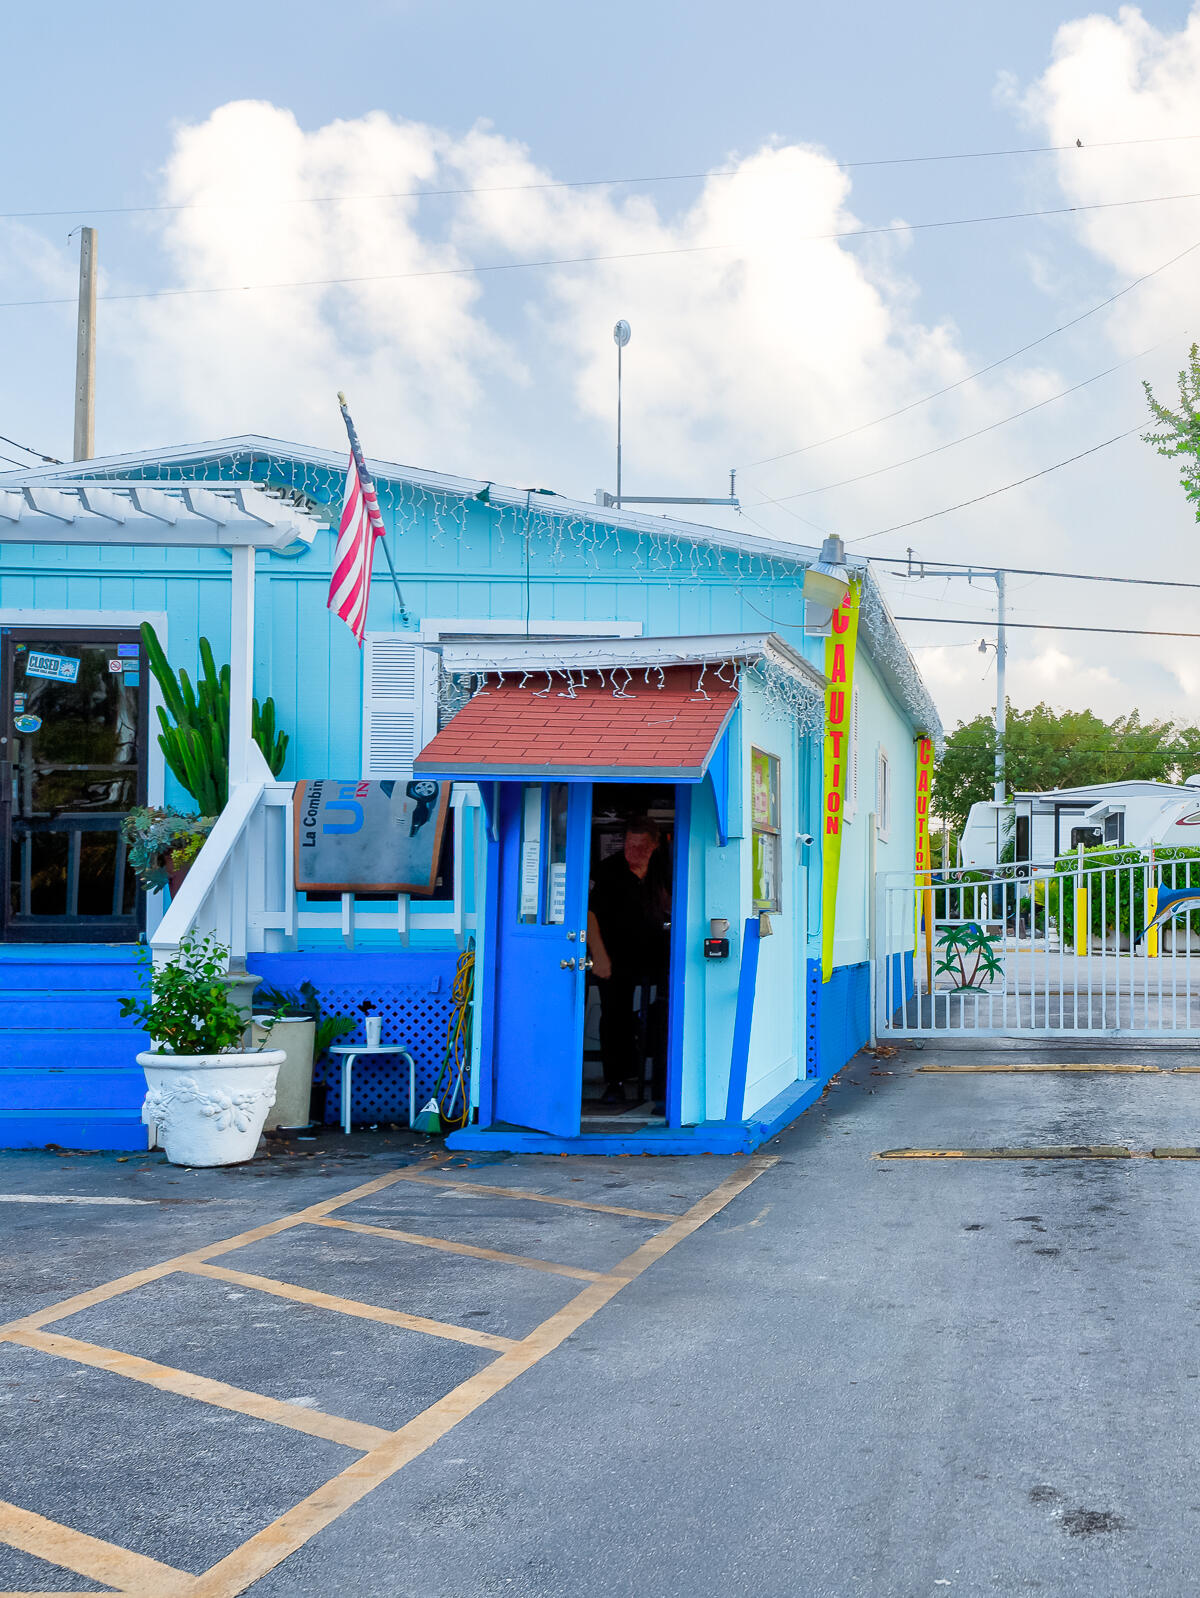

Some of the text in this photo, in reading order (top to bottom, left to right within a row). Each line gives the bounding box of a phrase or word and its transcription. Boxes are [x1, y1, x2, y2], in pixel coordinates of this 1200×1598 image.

[30, 655, 60, 672] CLOSED
[826, 592, 851, 835] CAUTION
[302, 832, 316, 848] La
